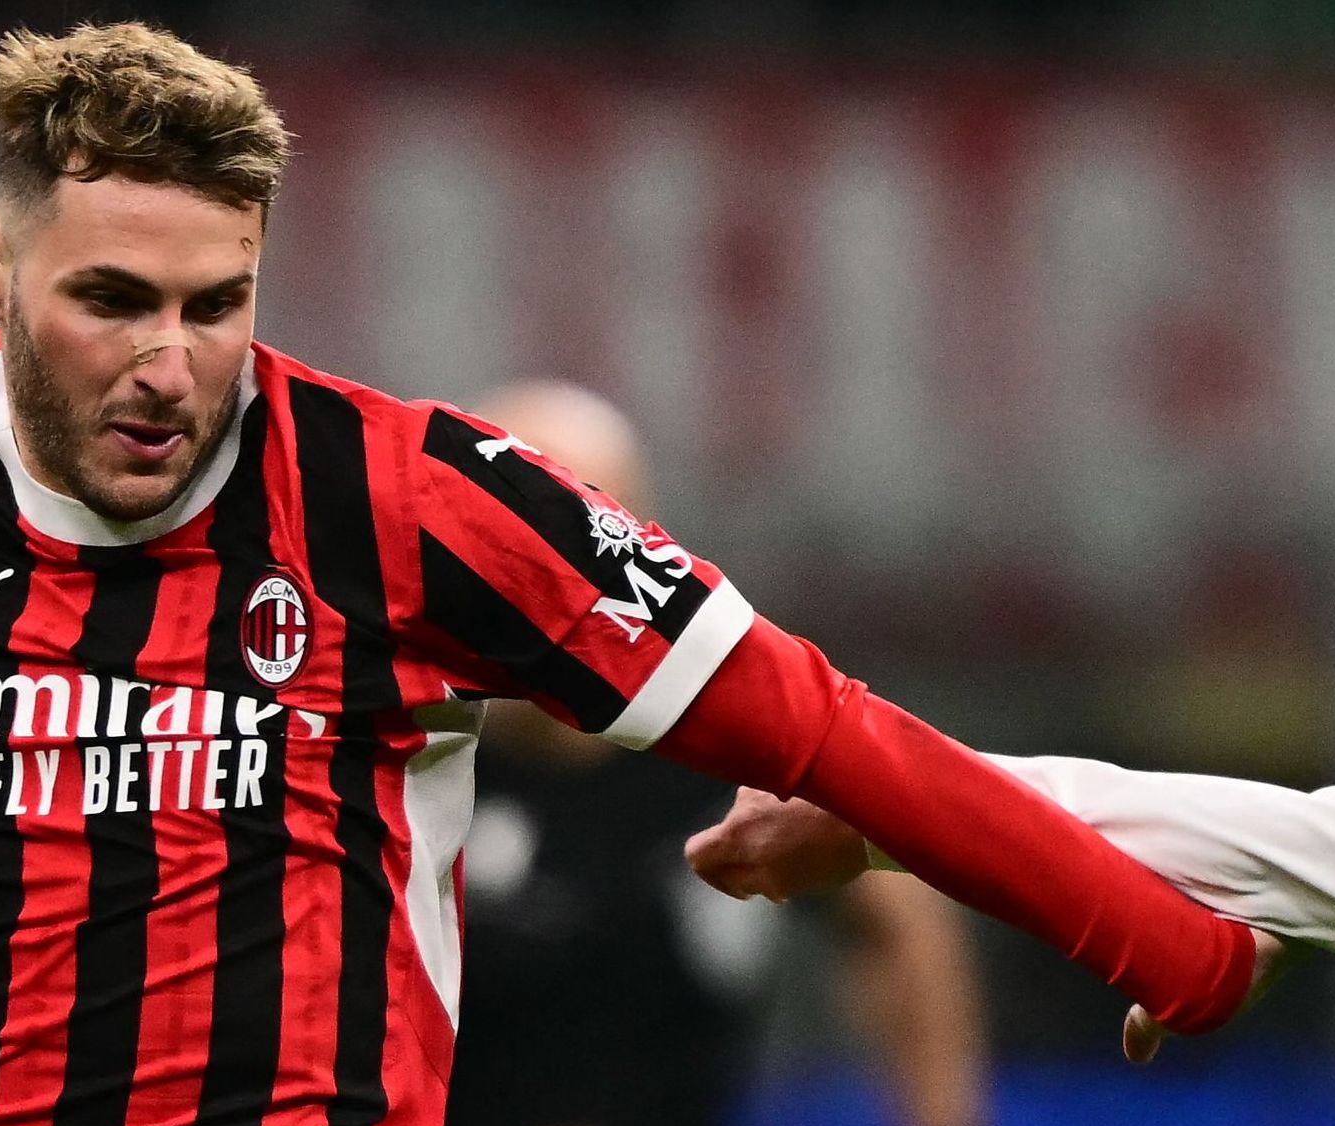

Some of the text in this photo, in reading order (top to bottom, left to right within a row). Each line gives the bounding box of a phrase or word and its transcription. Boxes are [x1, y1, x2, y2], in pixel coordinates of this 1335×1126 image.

[257, 581, 296, 602] ACM
[591, 535, 692, 643] MS
[259, 662, 292, 674] 1899
[82, 738, 267, 816] BETTER
